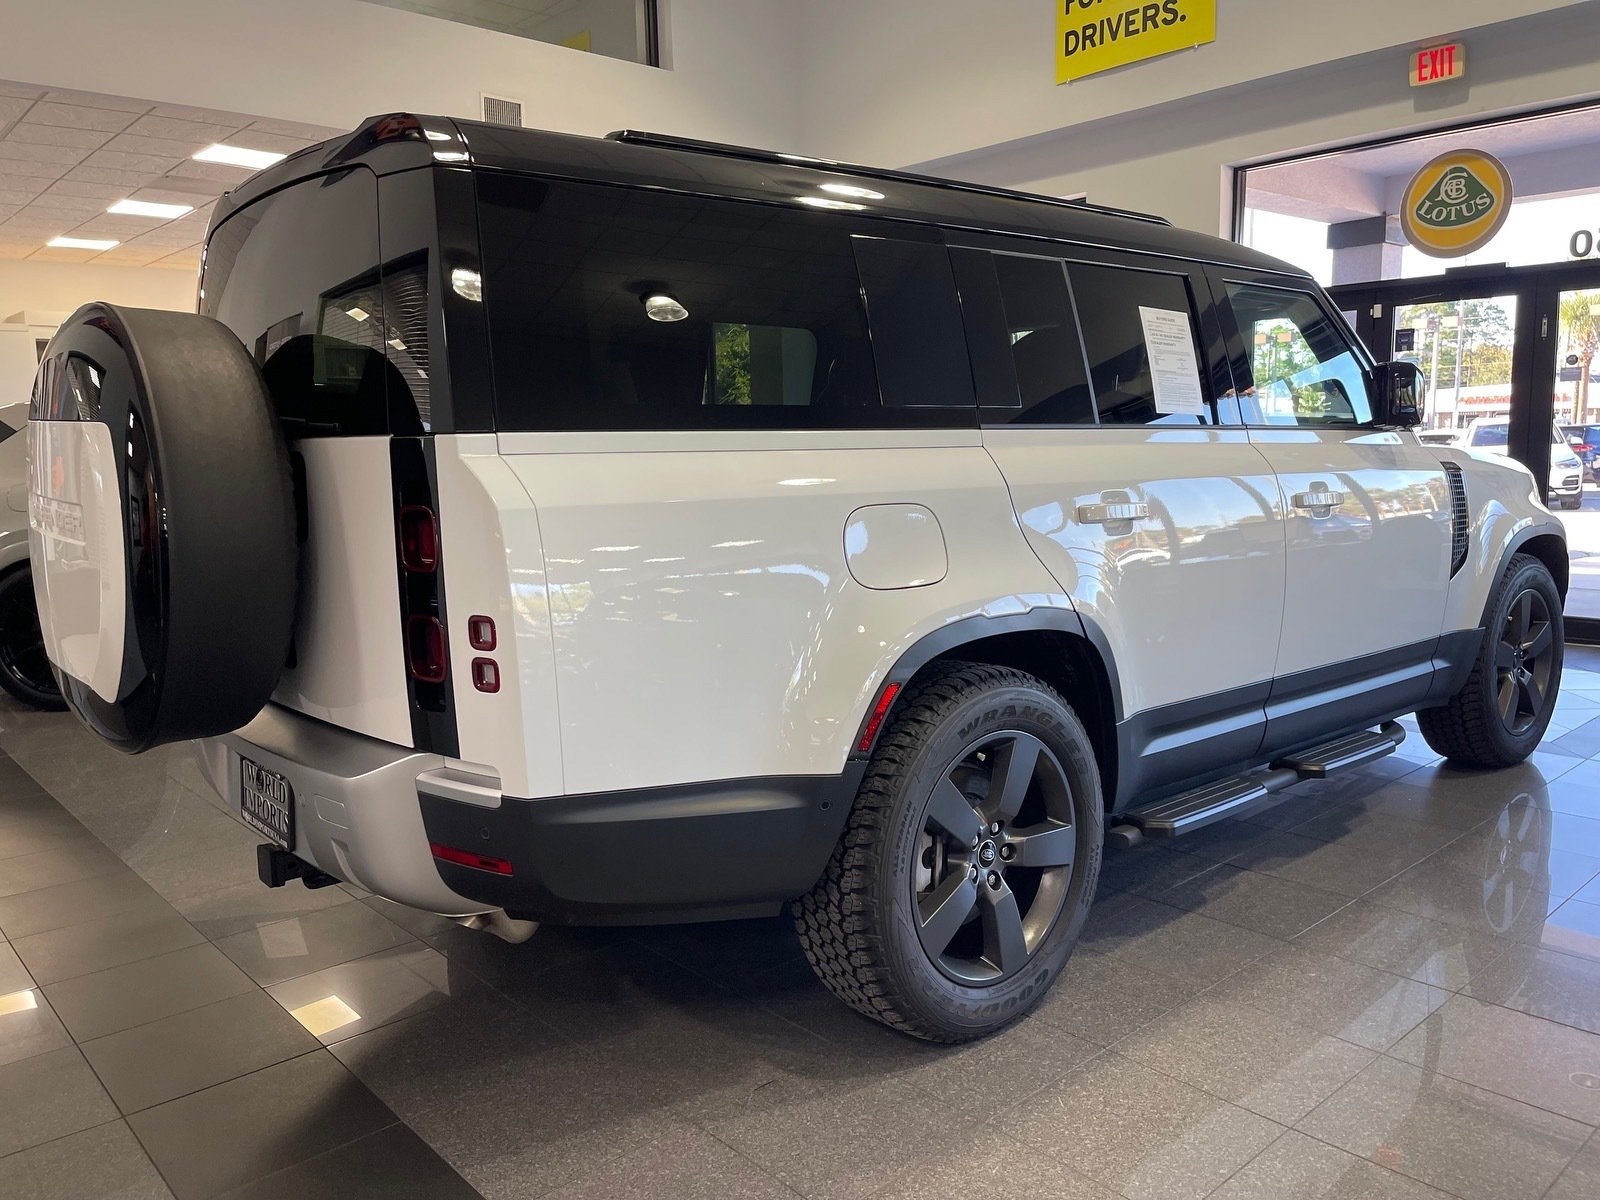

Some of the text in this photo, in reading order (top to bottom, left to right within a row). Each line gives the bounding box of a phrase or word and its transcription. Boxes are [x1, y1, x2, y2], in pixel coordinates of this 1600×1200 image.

[1065, 0, 1187, 57] DRIVERS.
[1417, 46, 1456, 82] EXIT
[1417, 193, 1491, 221] LOTUS
[957, 705, 1088, 776] WRANGLER
[242, 788, 289, 833] IMPORTS
